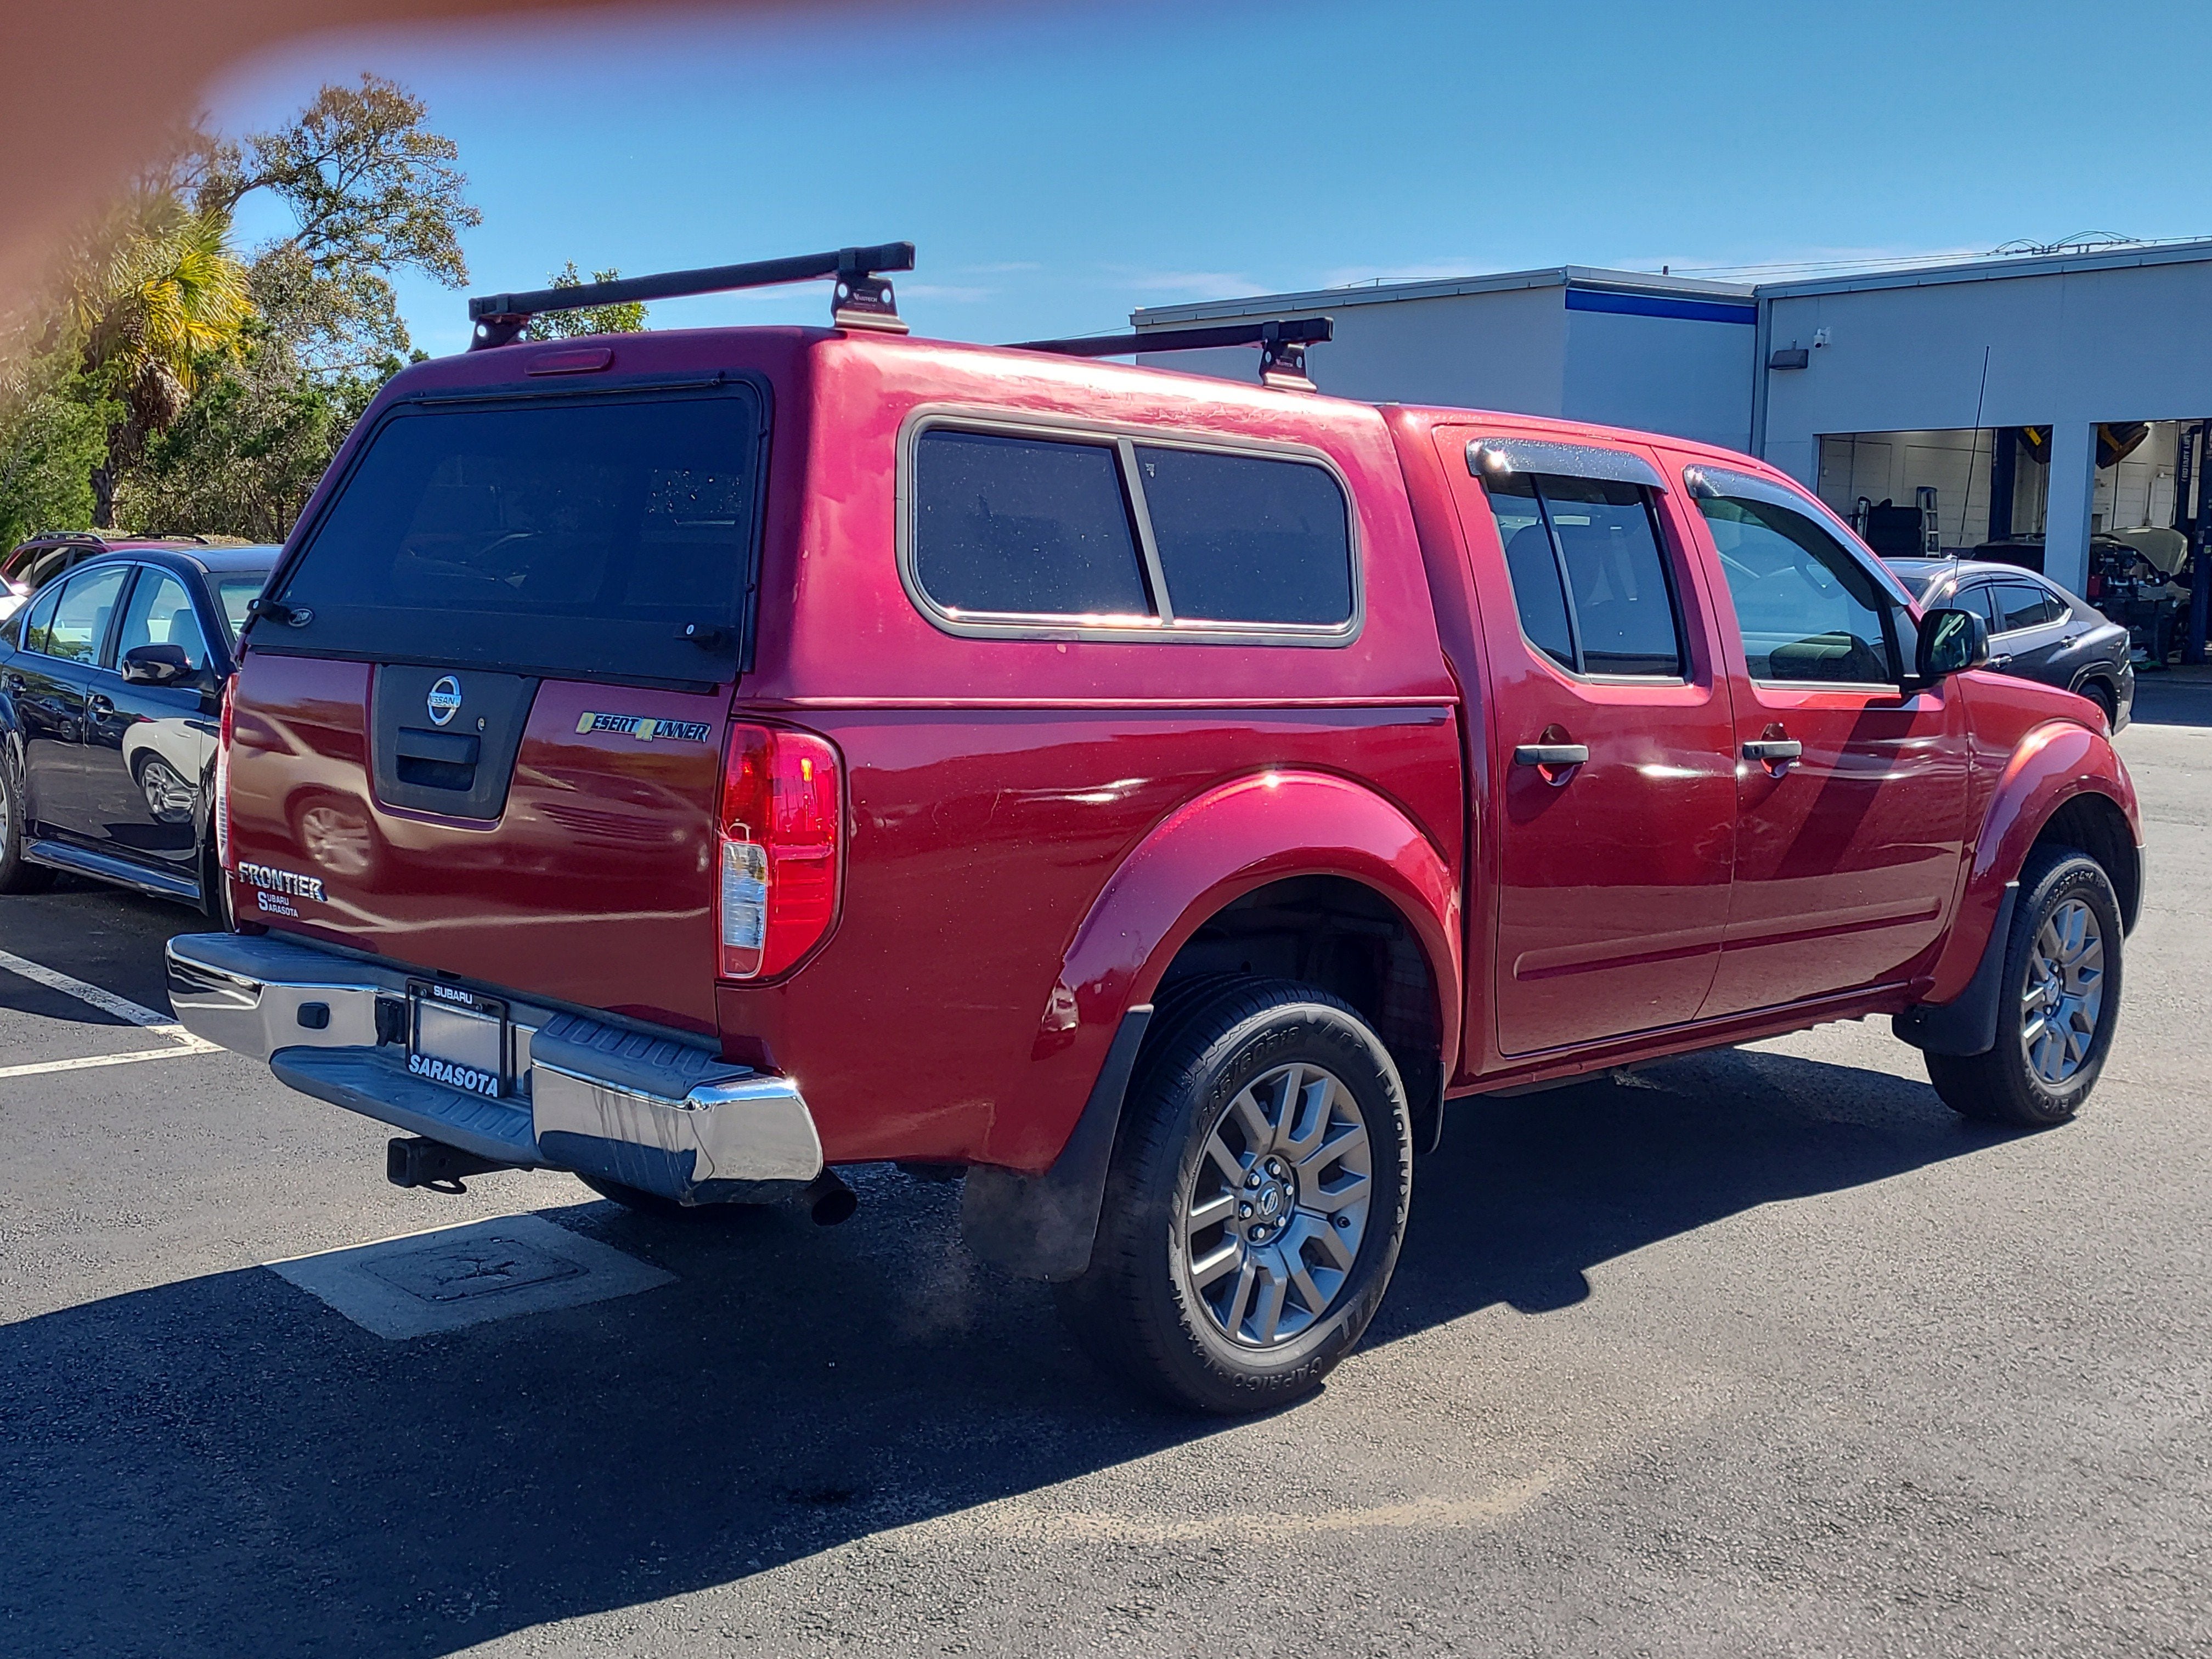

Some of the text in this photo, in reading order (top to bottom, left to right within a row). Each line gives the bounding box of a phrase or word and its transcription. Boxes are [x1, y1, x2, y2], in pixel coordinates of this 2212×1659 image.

[238, 861, 327, 902] FRONTIER
[433, 985, 473, 1005] SUBARU
[408, 1054, 499, 1098] SARASOTA
